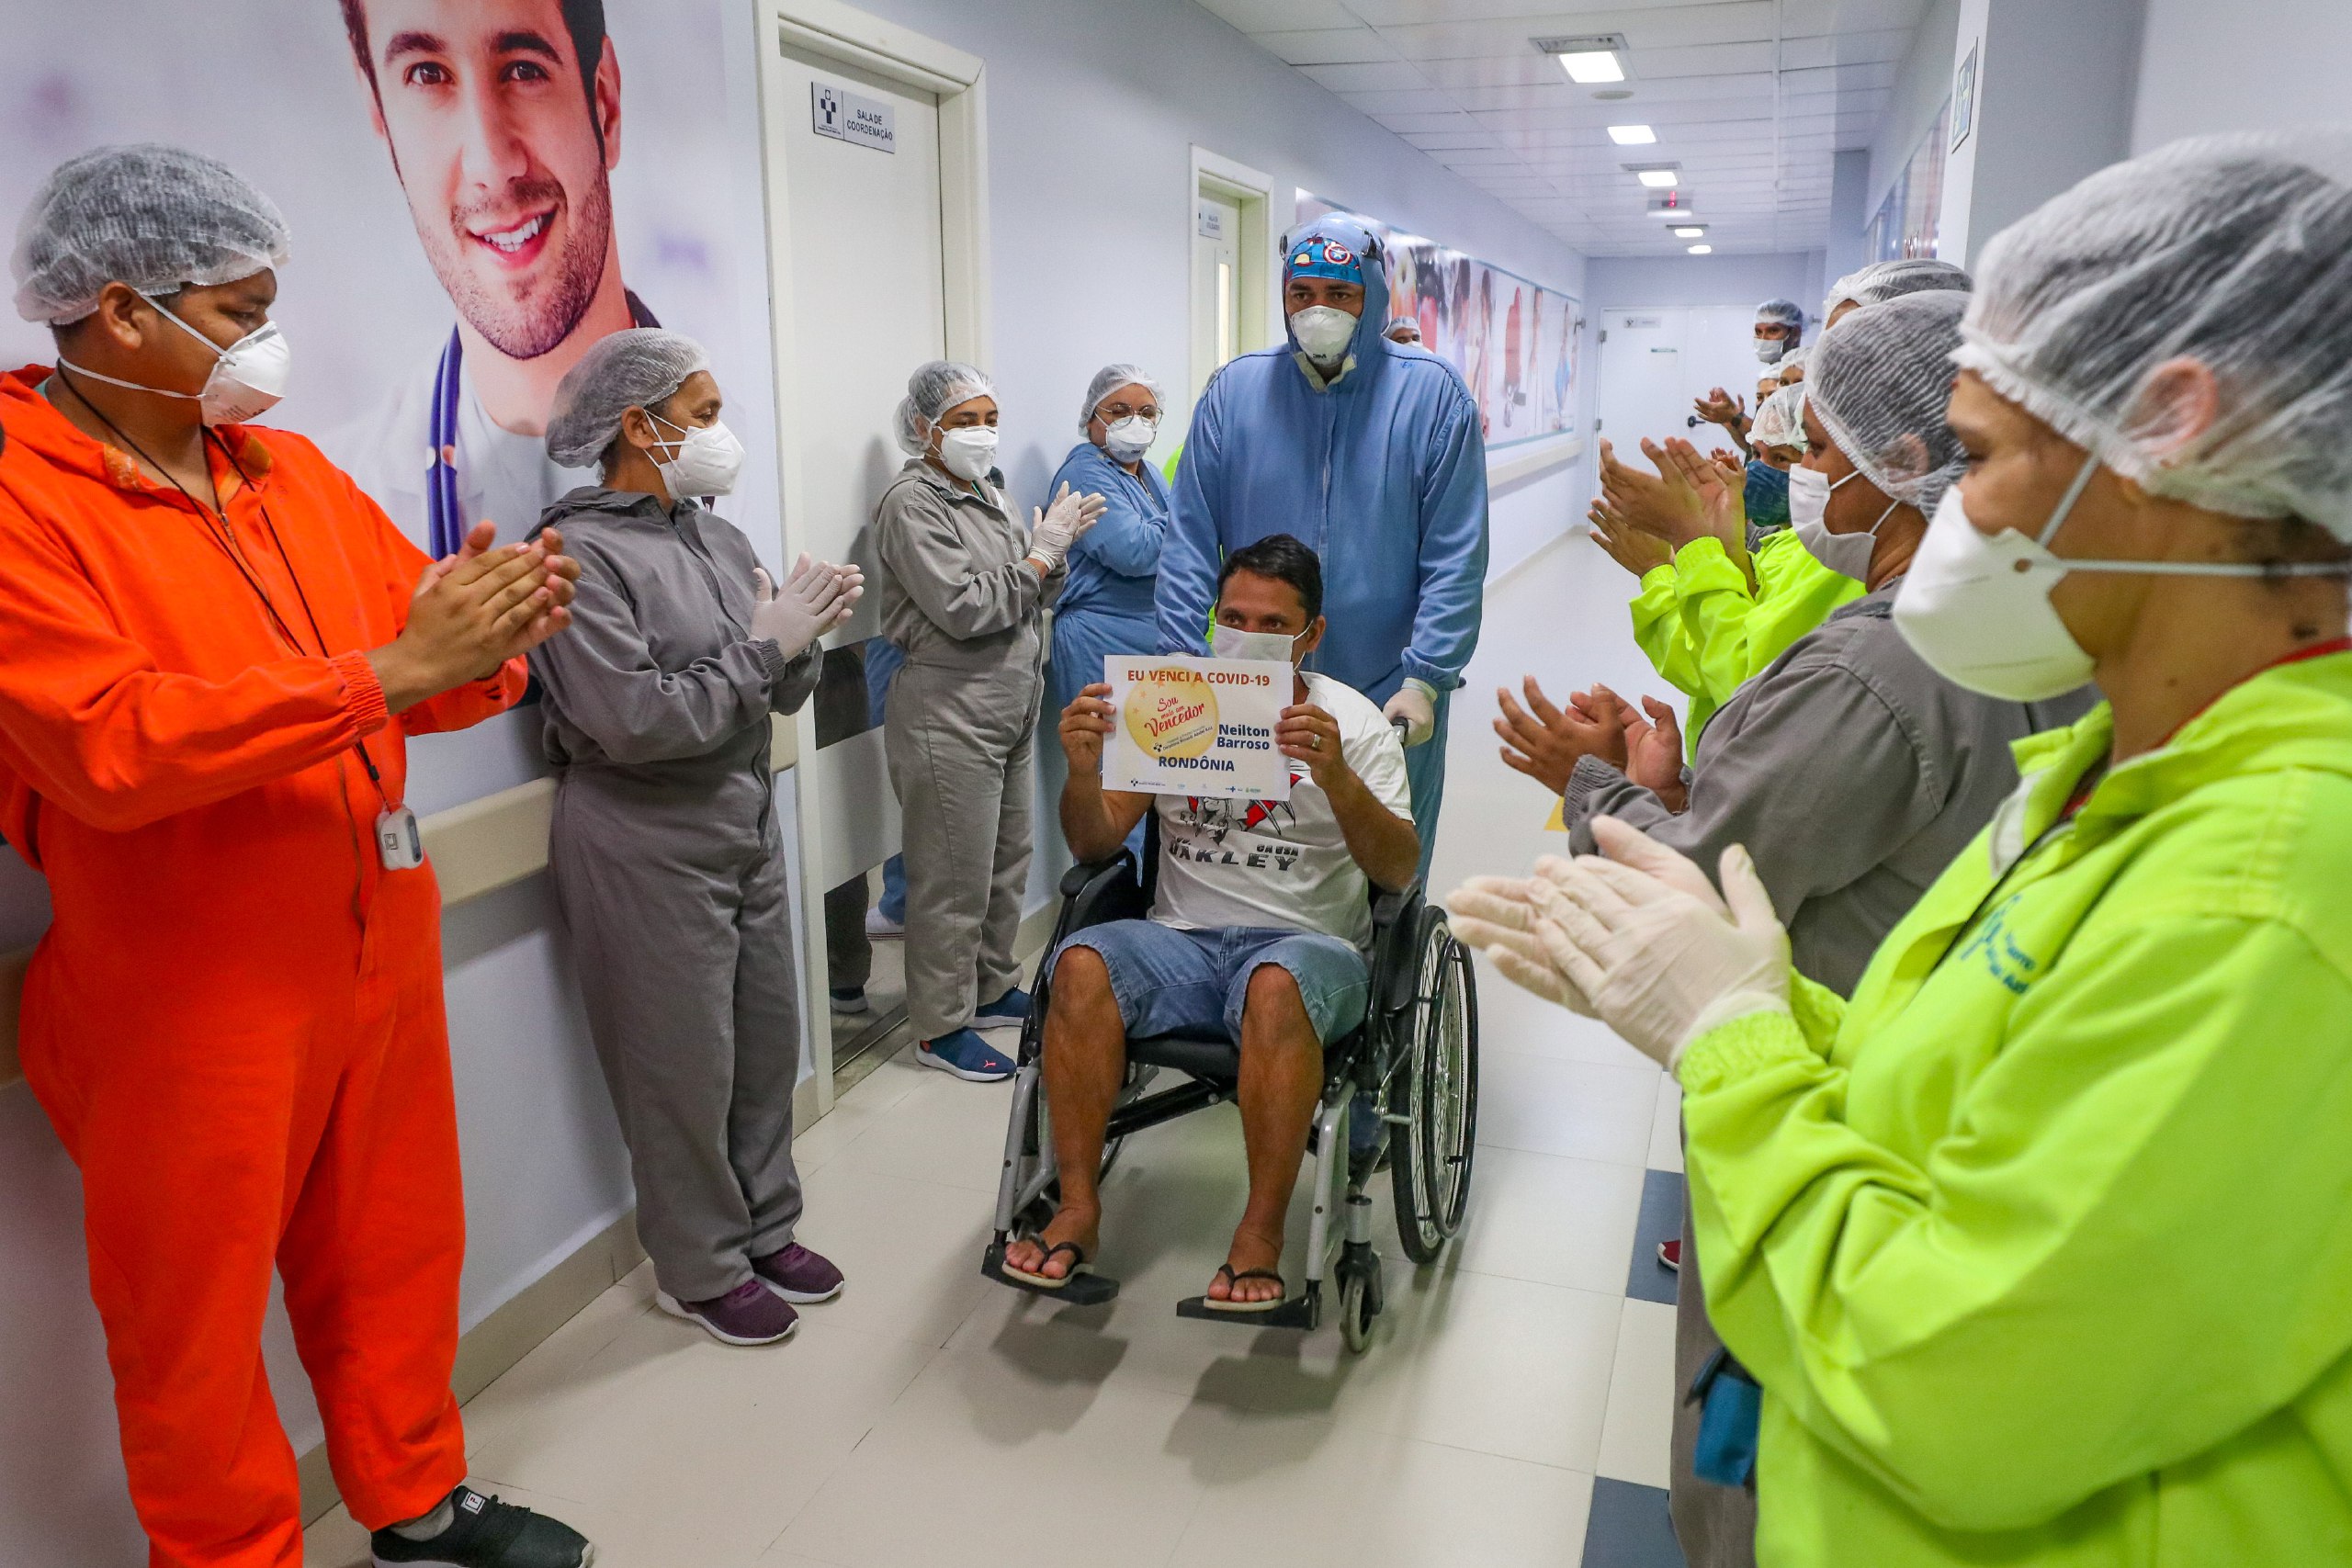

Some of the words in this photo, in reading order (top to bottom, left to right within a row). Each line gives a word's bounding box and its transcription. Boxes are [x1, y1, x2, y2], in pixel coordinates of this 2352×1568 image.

[857, 109, 874, 123] SALA
[875, 115, 883, 125] DE
[847, 120, 893, 141] COORDENAÇÃO
[1128, 671, 1145, 682] EU
[1148, 671, 1191, 682] VENCI
[1194, 671, 1204, 683] A
[1207, 672, 1271, 686] COVID-19
[1157, 696, 1179, 712] Sou
[1144, 703, 1204, 738] Vencedor
[1218, 724, 1270, 738] Neilton
[1216, 736, 1271, 750] Barroso
[1159, 755, 1235, 772] RONDÔNIA
